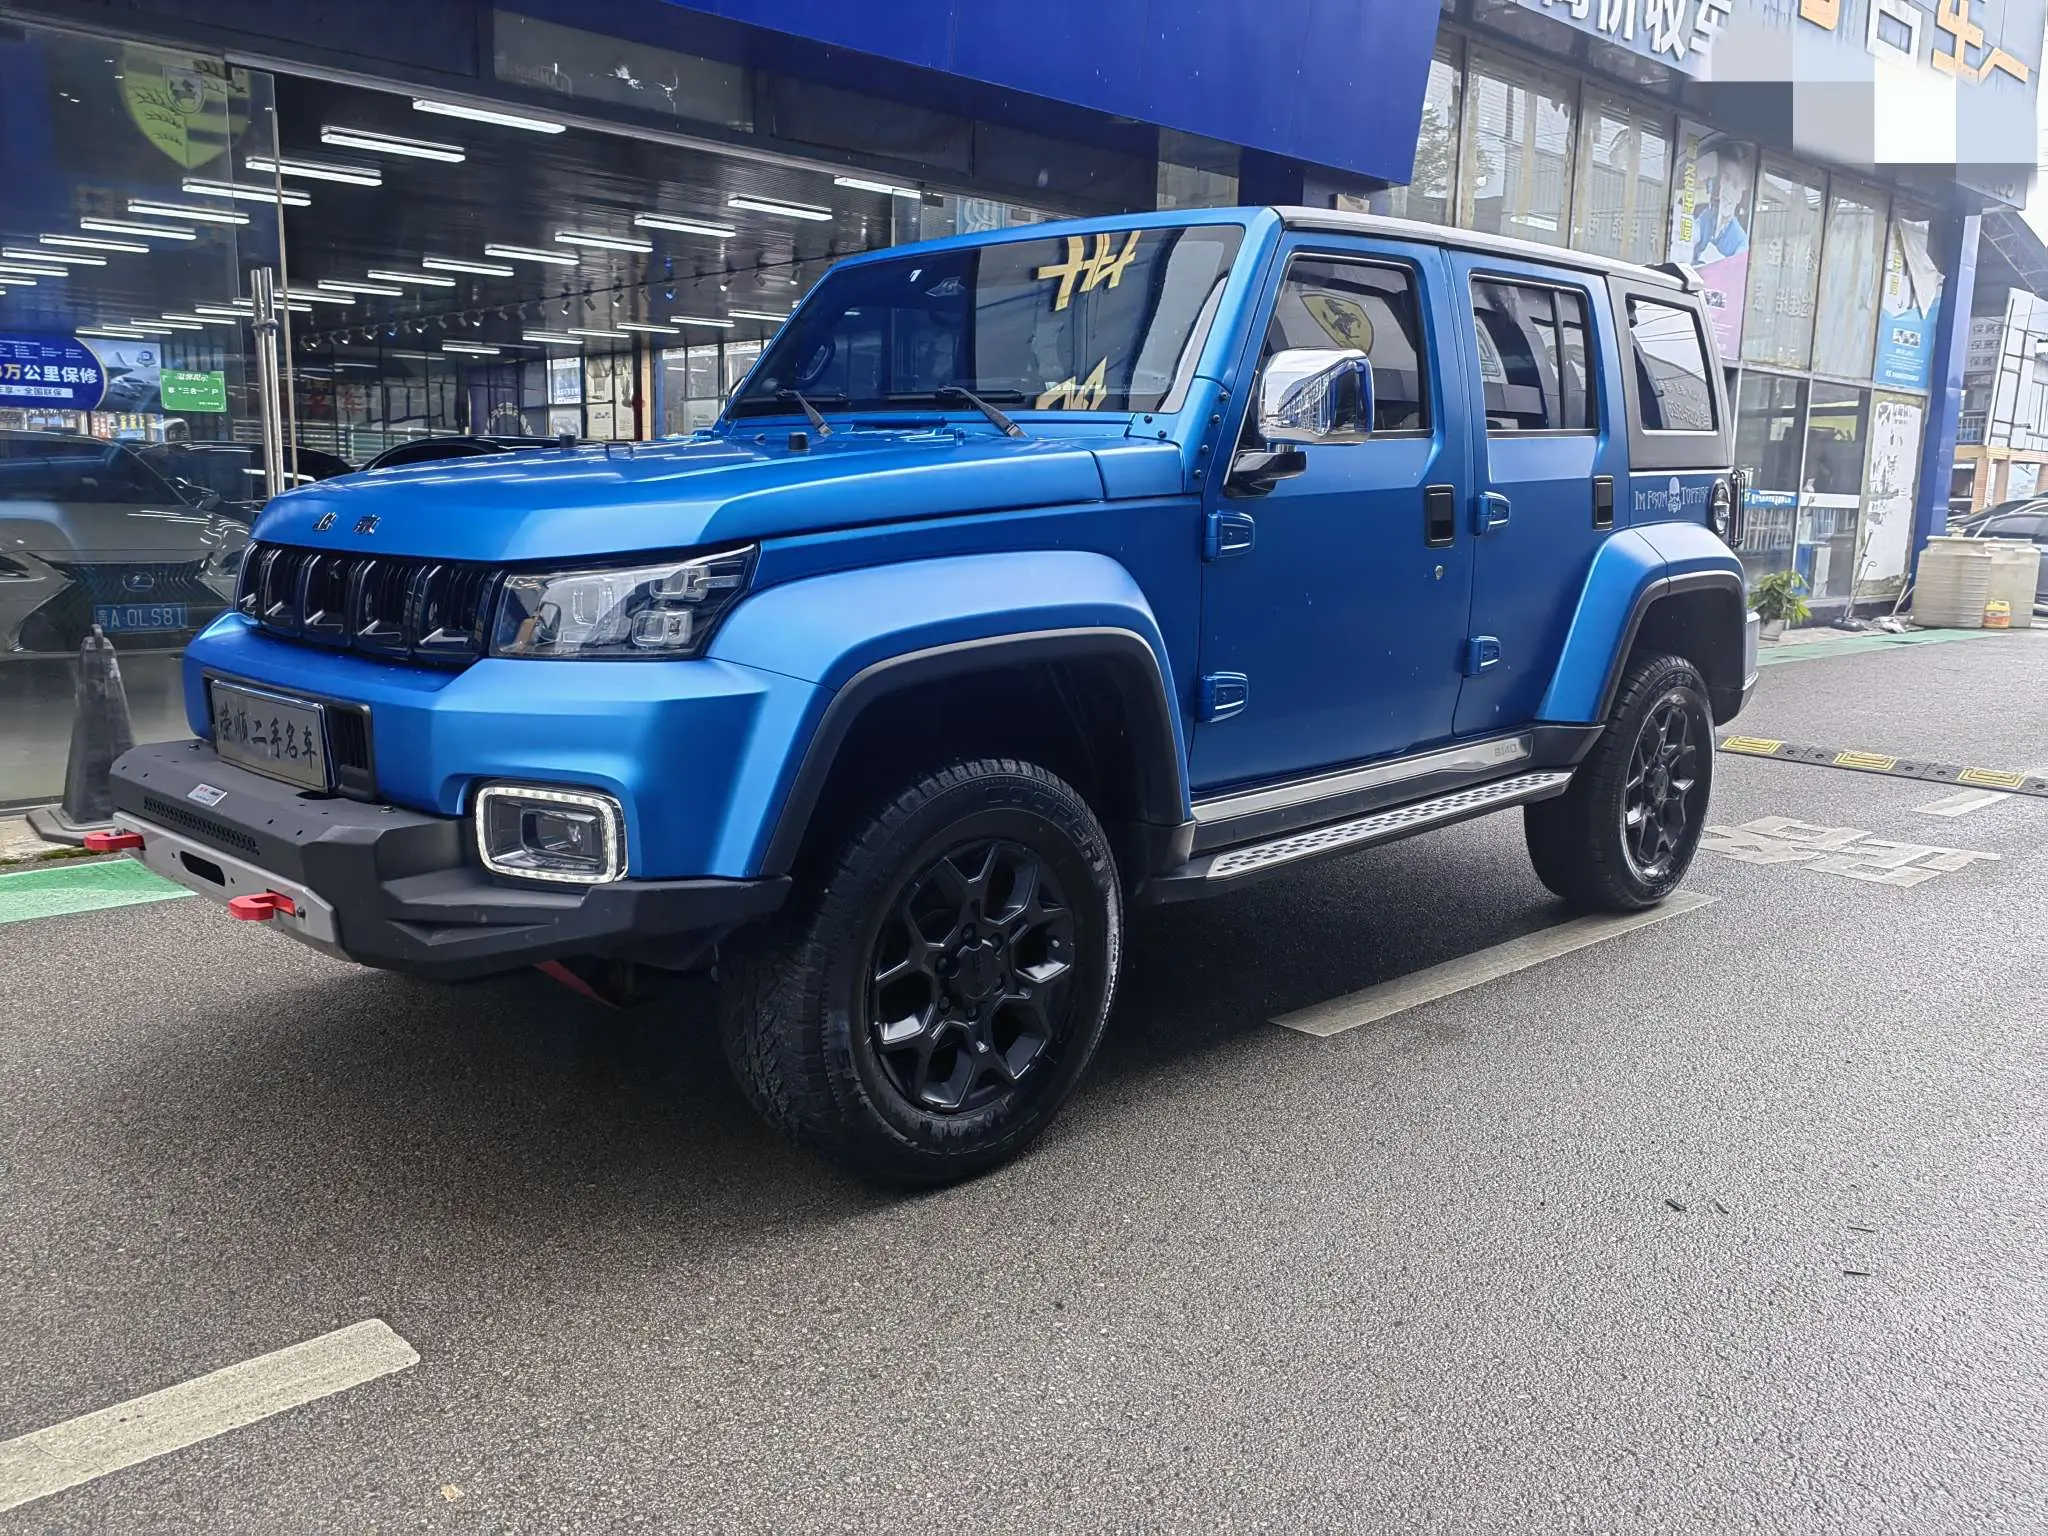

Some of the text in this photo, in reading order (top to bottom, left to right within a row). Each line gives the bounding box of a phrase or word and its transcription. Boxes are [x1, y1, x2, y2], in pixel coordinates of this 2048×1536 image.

[0, 363, 98, 385] 万公里保修
